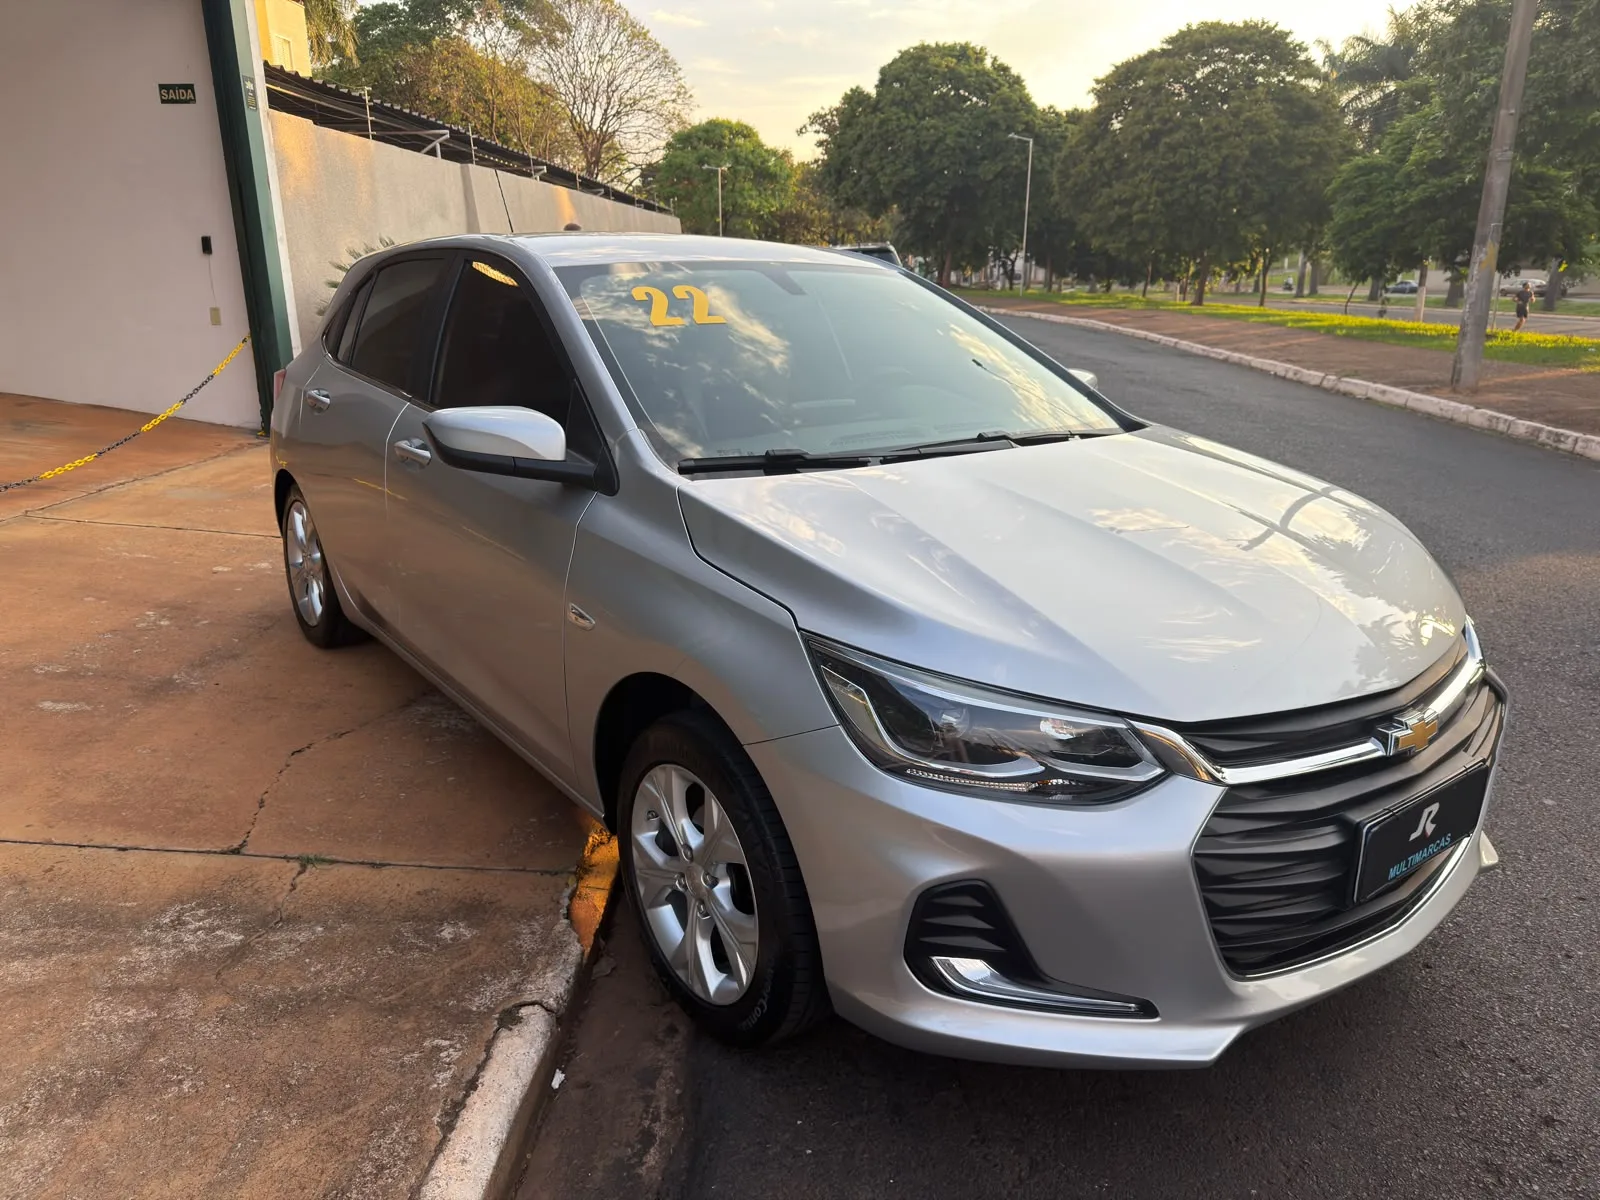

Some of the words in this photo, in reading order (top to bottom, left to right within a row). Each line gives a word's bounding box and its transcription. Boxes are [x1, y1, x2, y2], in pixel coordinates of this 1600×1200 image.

[161, 87, 195, 100] SAÍDA
[631, 284, 727, 327] 22
[1388, 833, 1451, 880] MULTIMARCAS
